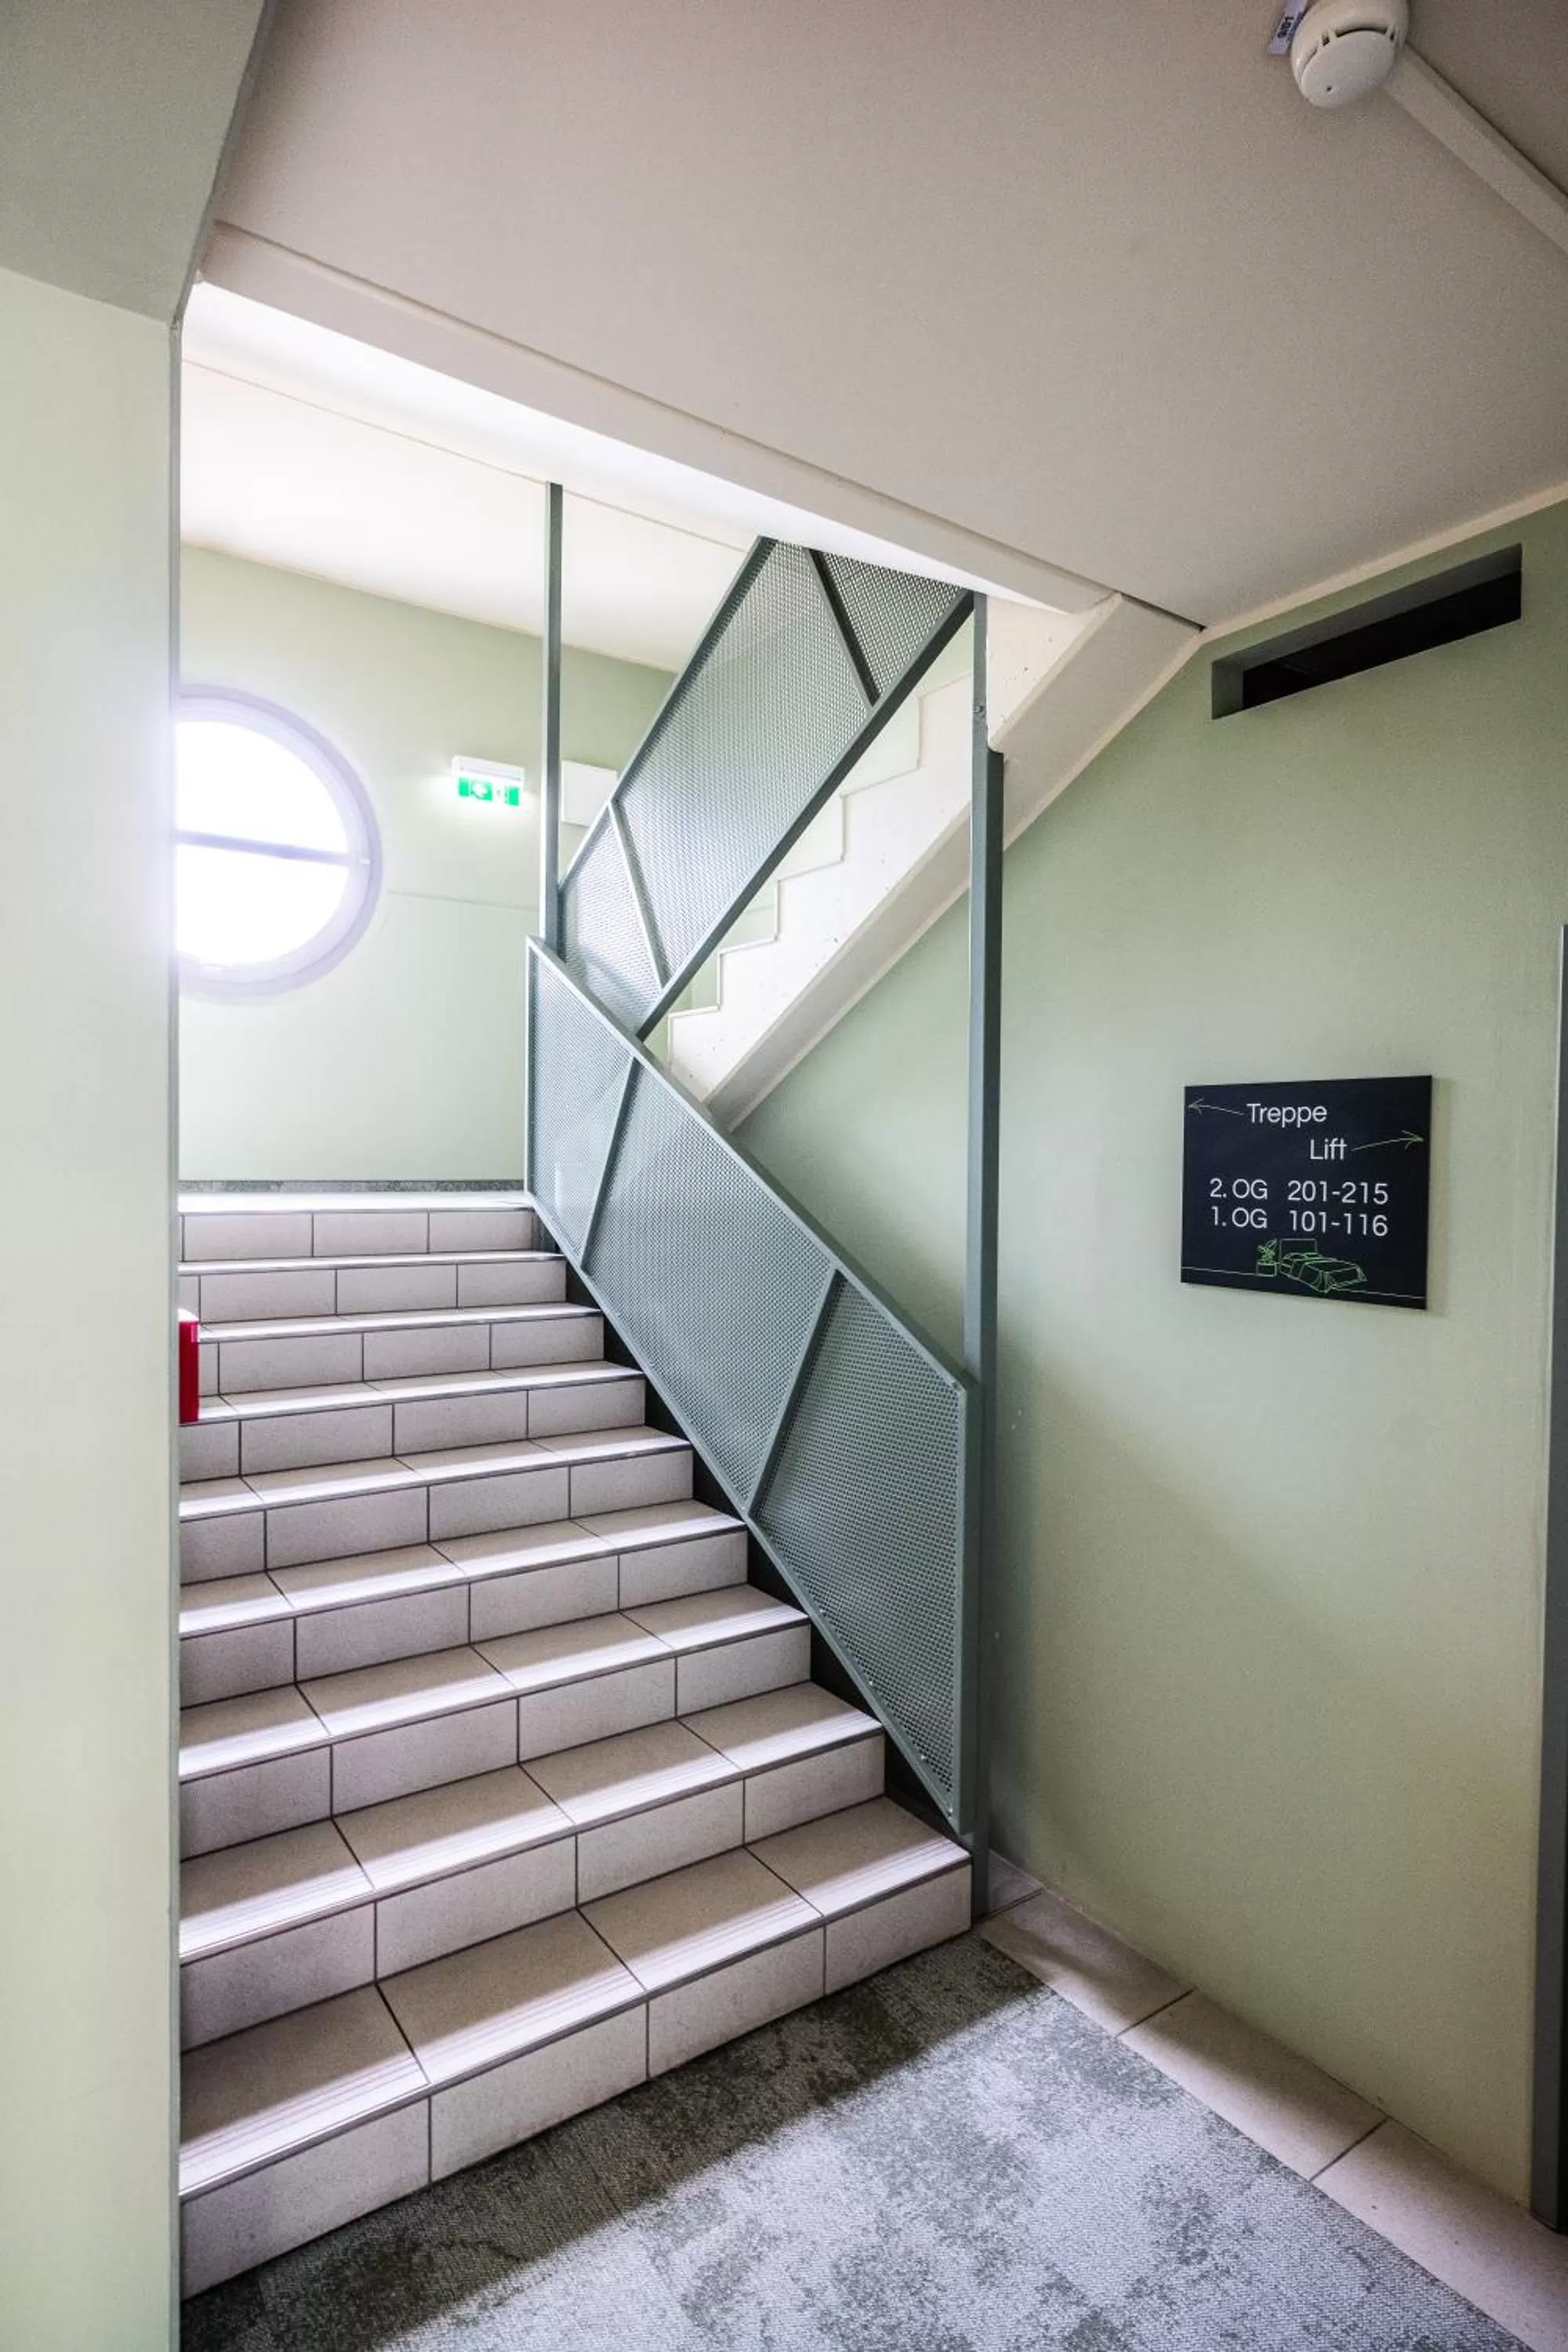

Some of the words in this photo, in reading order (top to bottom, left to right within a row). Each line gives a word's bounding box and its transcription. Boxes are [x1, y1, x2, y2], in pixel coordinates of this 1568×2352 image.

[1246, 1103, 1327, 1128] Treppe
[1310, 1138, 1347, 1160] Lift
[1287, 1180, 1388, 1205] 201-215
[1290, 1210, 1388, 1236] 101-116
